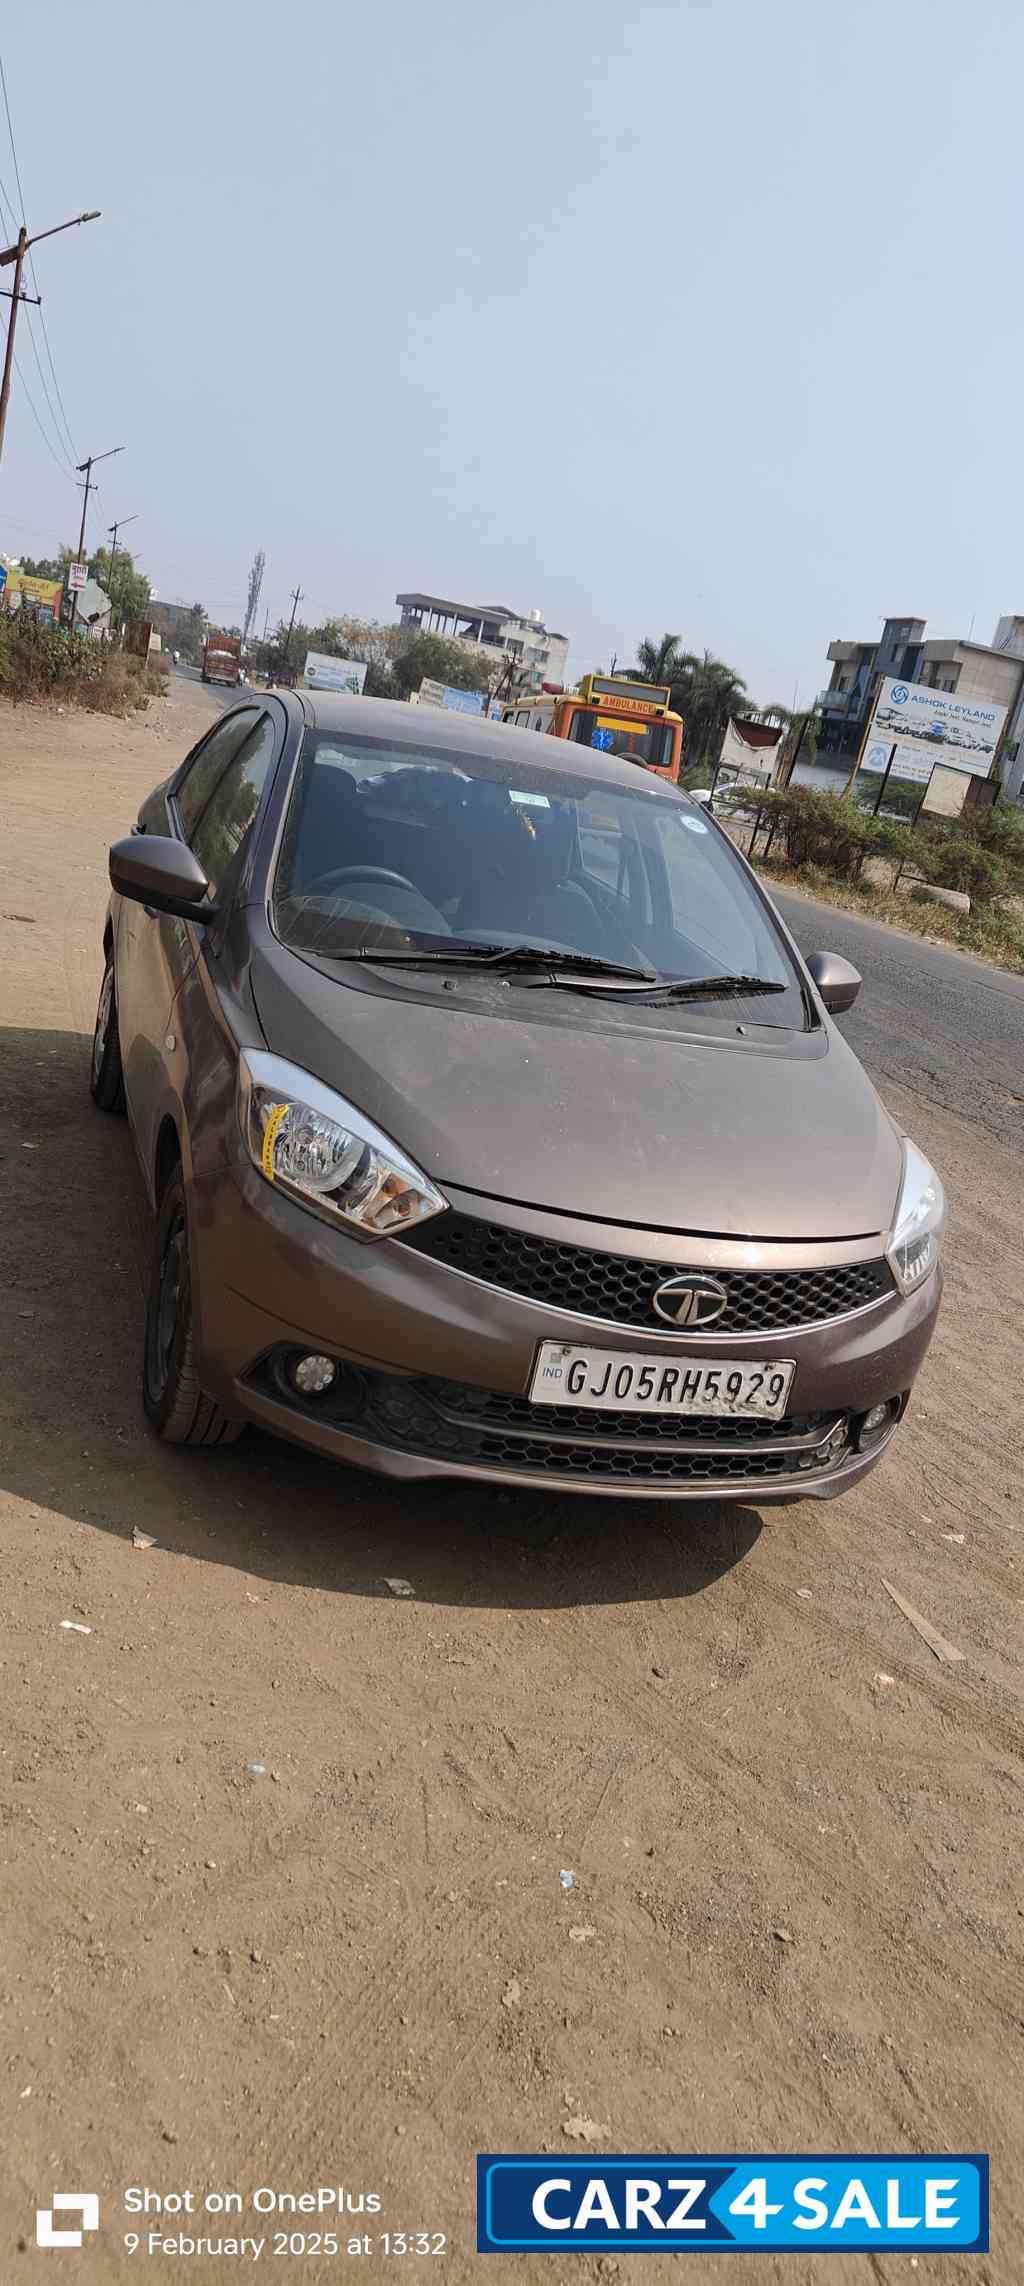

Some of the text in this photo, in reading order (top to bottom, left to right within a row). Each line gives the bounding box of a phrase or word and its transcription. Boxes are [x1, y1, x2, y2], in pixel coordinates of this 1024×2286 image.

[911, 695, 947, 709] ASHOK
[949, 704, 996, 721] LEYLAND
[541, 1366, 563, 1379] IND
[567, 1359, 786, 1407] GJ05RH5929
